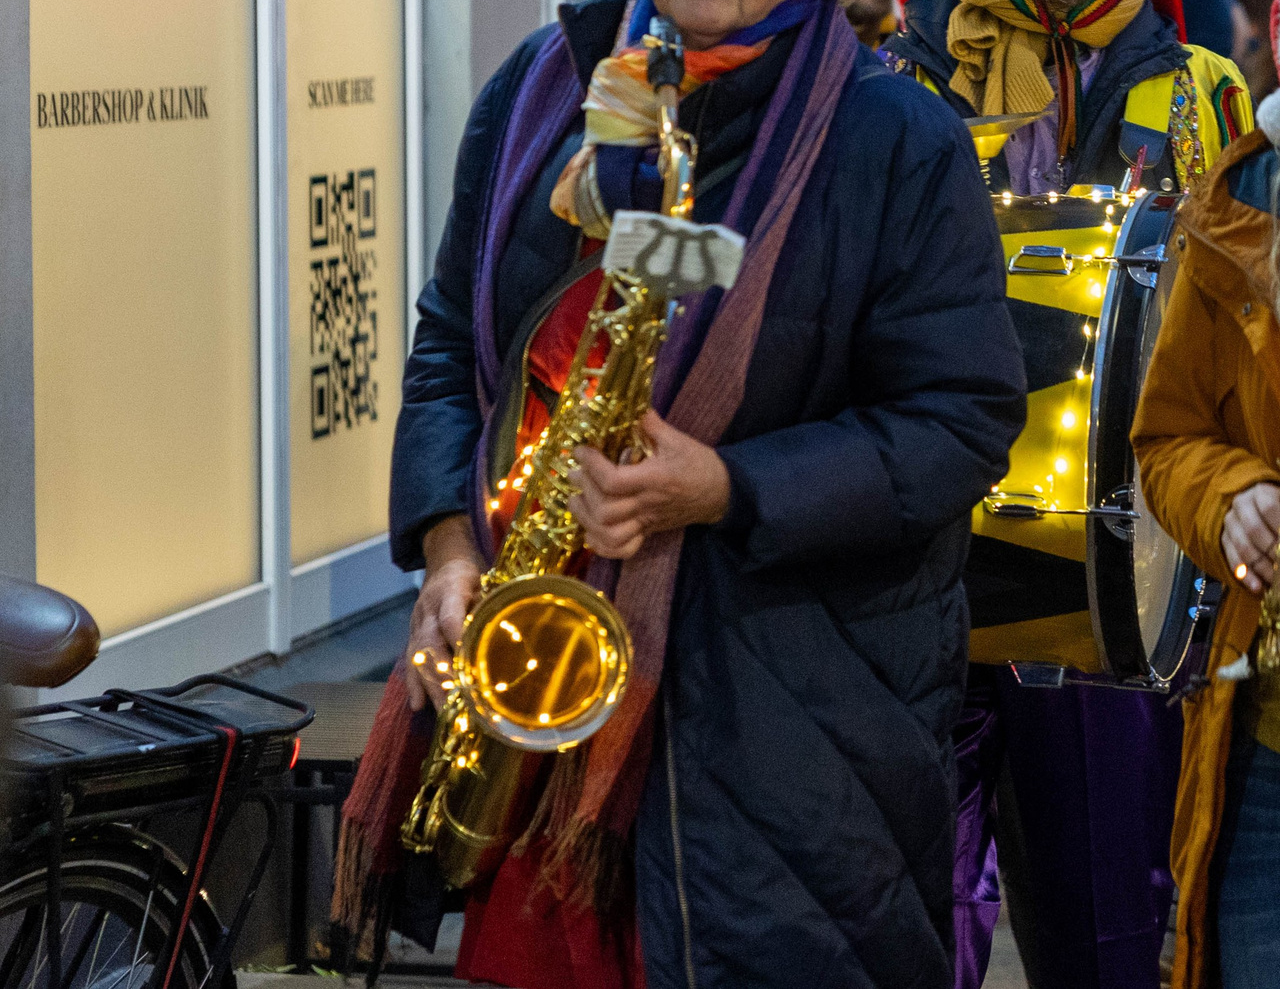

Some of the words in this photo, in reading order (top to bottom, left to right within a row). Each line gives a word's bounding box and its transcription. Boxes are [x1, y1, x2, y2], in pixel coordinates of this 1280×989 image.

[37, 88, 144, 129] BARBERSHOP
[147, 91, 157, 123] &
[159, 85, 209, 122] KLINIK
[308, 80, 334, 108] SCAN
[335, 79, 349, 106] ME
